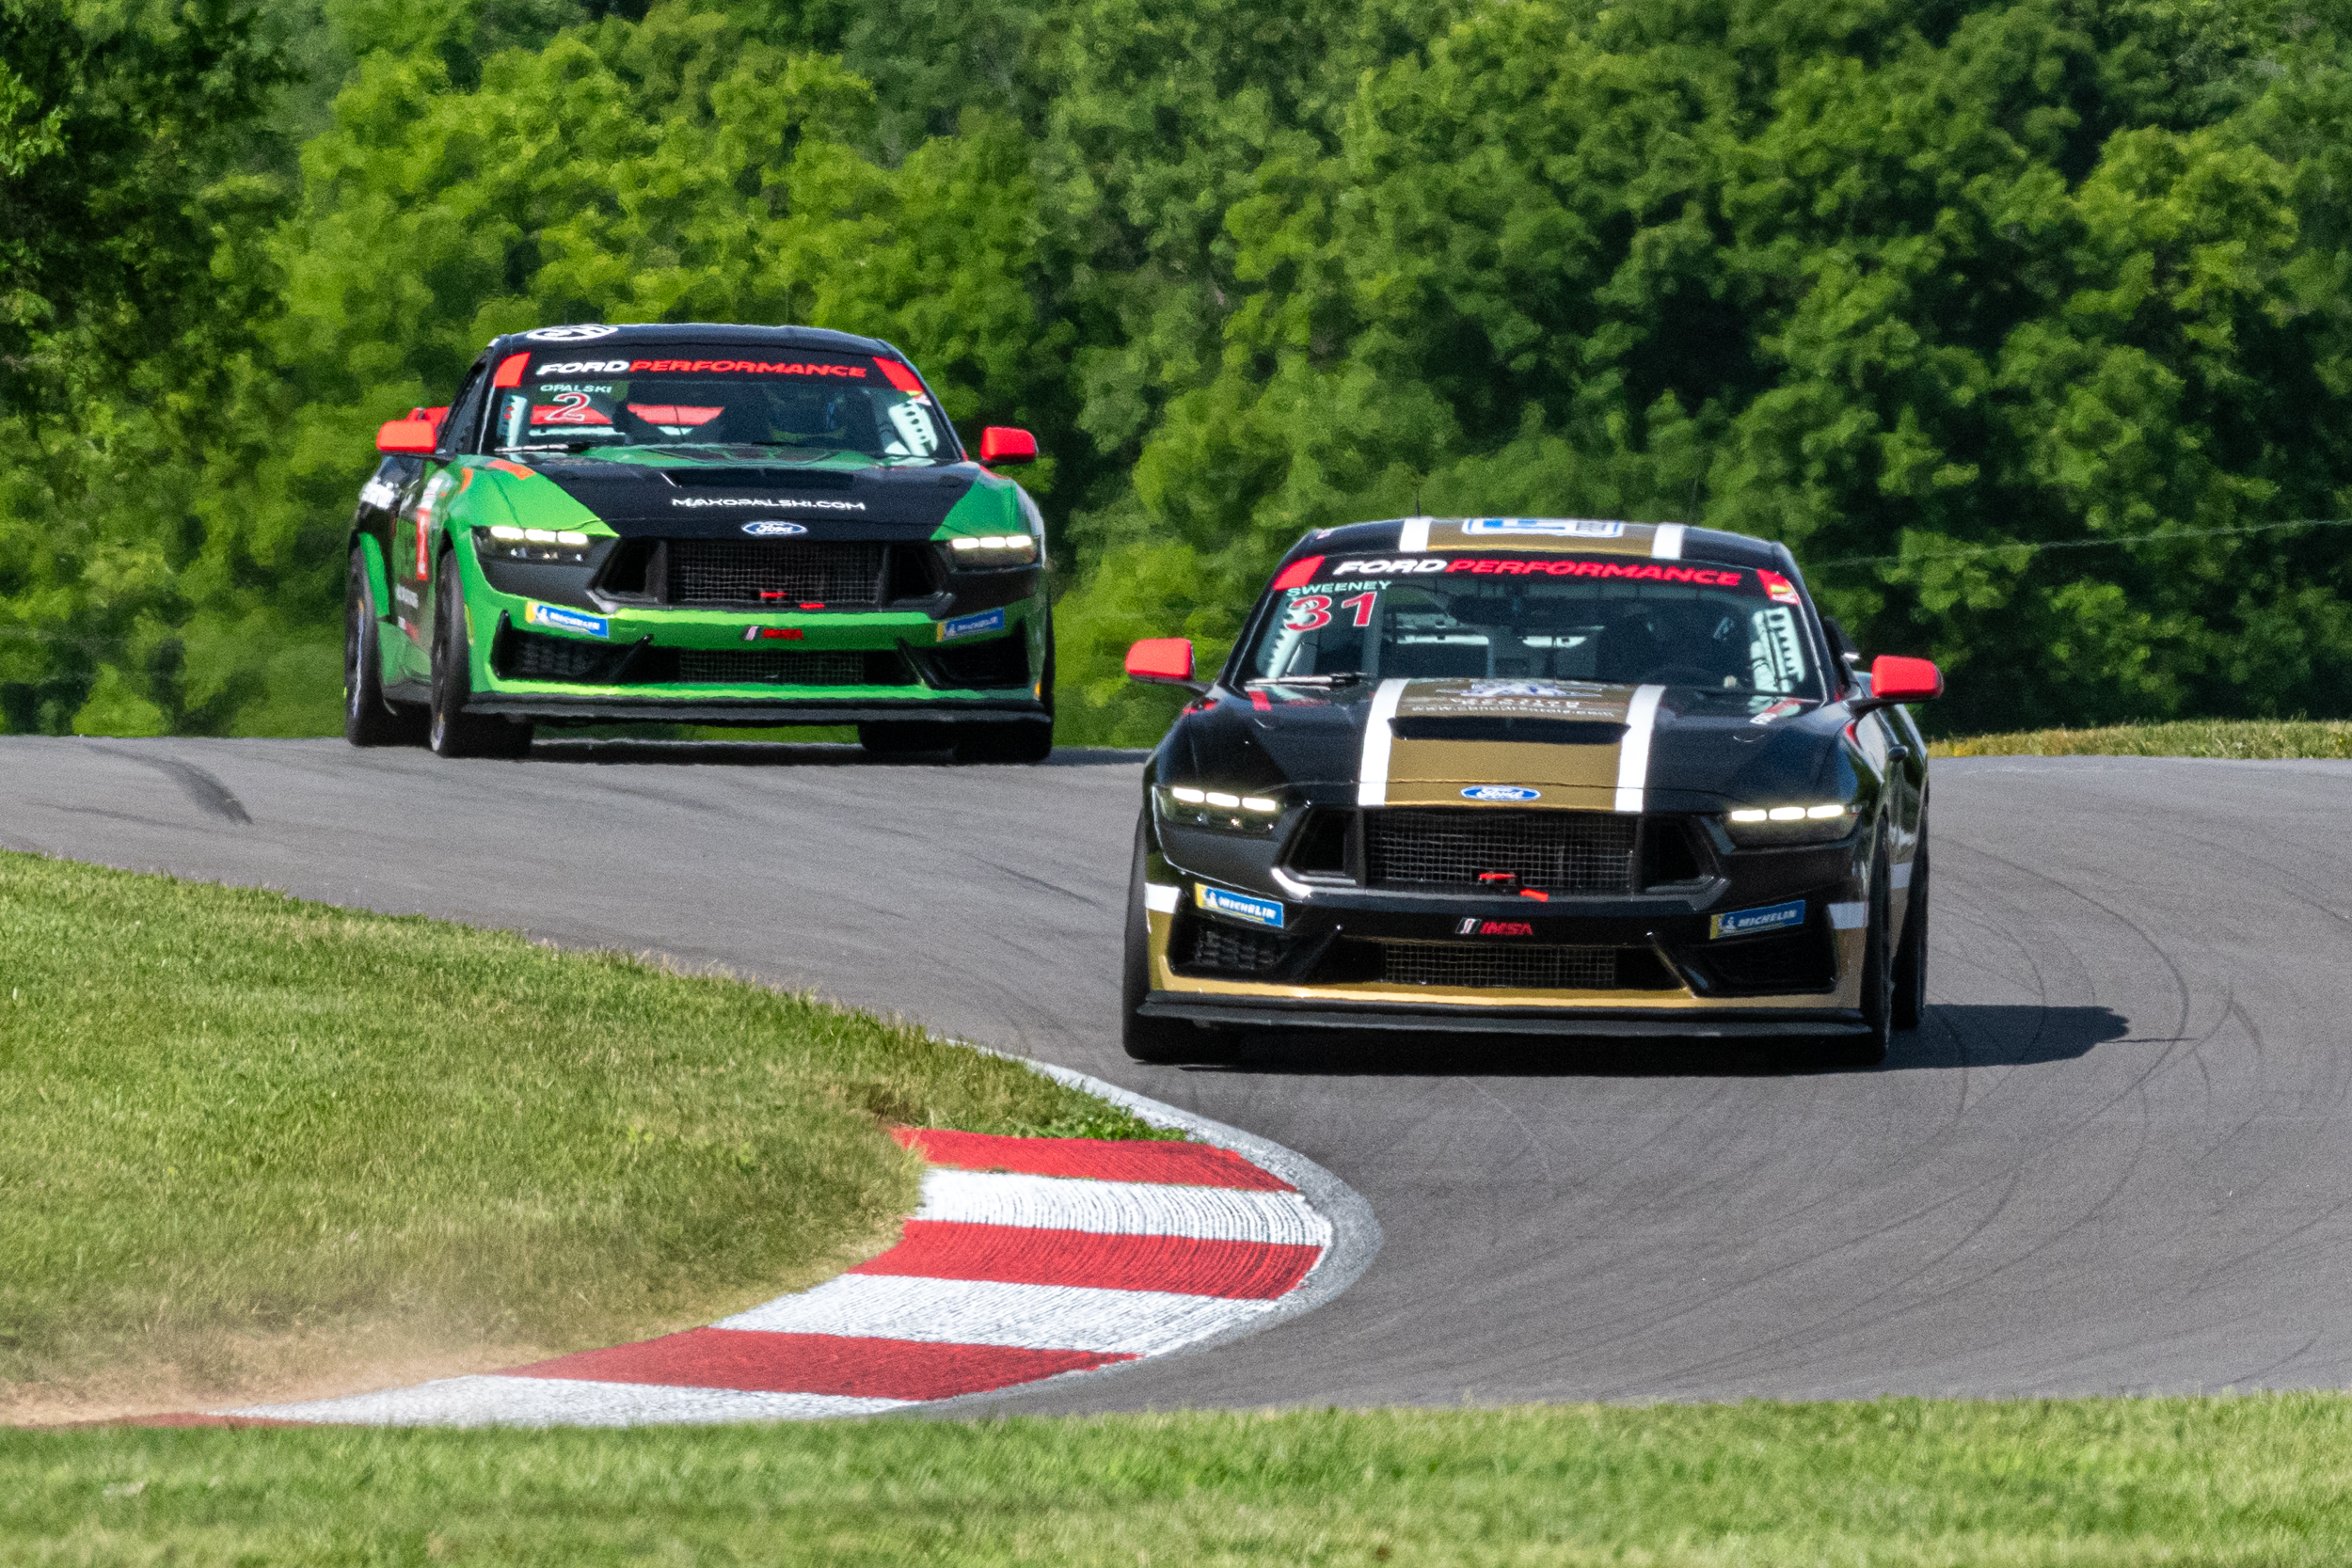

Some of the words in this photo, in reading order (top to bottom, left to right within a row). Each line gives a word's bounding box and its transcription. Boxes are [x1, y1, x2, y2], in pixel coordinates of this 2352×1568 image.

[535, 360, 629, 375] FORD
[628, 359, 867, 378] PERFORMANCE
[540, 384, 612, 394] OPALSKI
[545, 391, 592, 422] 2
[671, 497, 866, 512] MAXOPALSKI.COM
[1332, 559, 1448, 576] FORD
[1446, 559, 1741, 586] PERFORMANCE
[1286, 580, 1392, 597] SWEENEY
[1283, 591, 1378, 632] 31
[1217, 895, 1277, 920] MICHELIN
[1738, 909, 1798, 928] MICHELIN
[1480, 921, 1534, 936] IMSA
